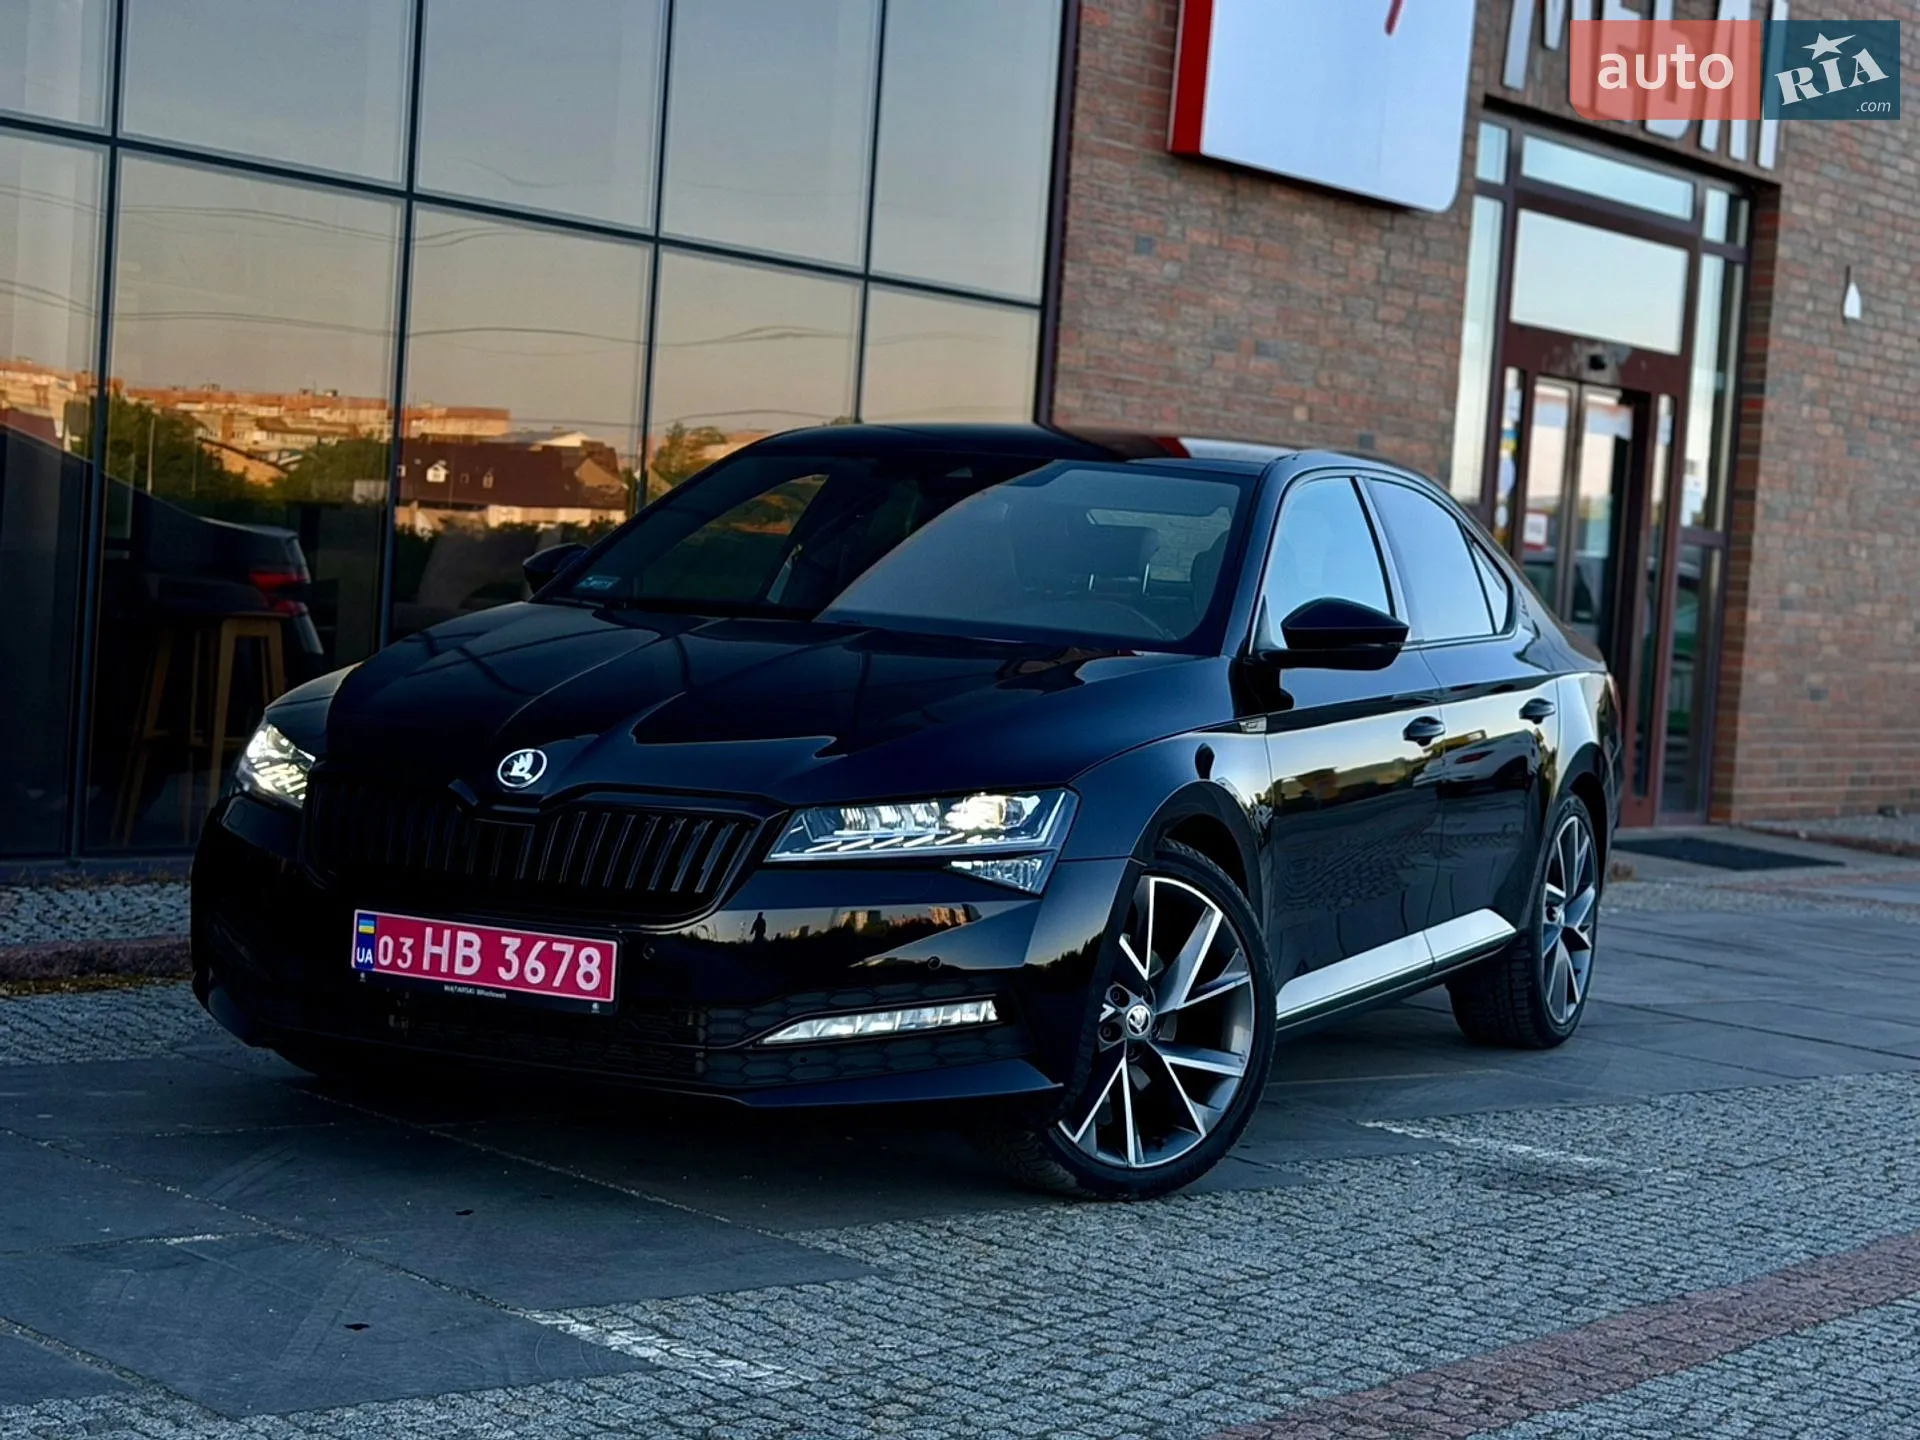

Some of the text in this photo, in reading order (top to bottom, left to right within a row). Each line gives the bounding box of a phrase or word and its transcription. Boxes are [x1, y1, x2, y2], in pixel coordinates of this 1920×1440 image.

[356, 946, 374, 965] UA
[377, 926, 602, 991] 03 HB 3678
